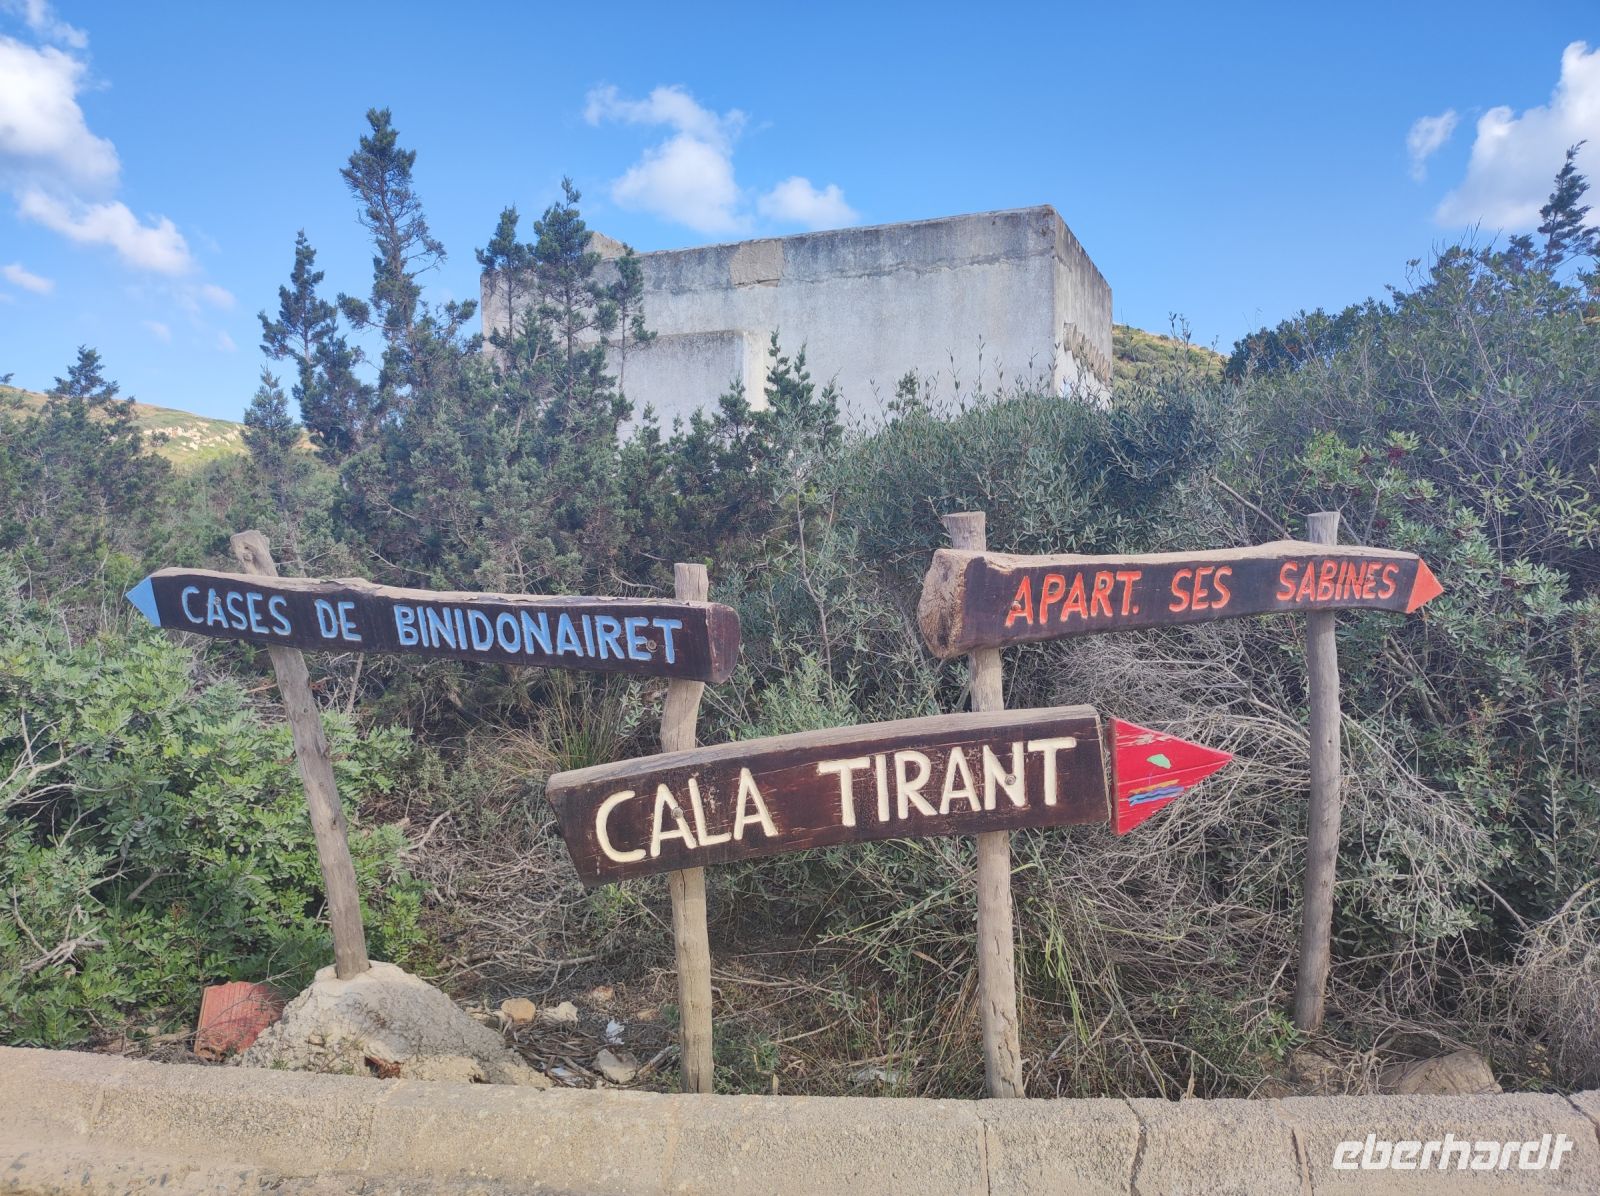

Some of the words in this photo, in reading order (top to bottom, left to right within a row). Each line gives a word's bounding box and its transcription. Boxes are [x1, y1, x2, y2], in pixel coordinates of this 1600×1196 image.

[181, 585, 292, 637] CASES
[314, 598, 363, 642] DE
[395, 604, 684, 665] BINIDONAIRET
[1005, 570, 1142, 627] APART.
[1168, 565, 1233, 613] SES
[1276, 559, 1399, 602] SABINES
[595, 767, 779, 864] CALA
[816, 736, 1078, 828] TIRANT
